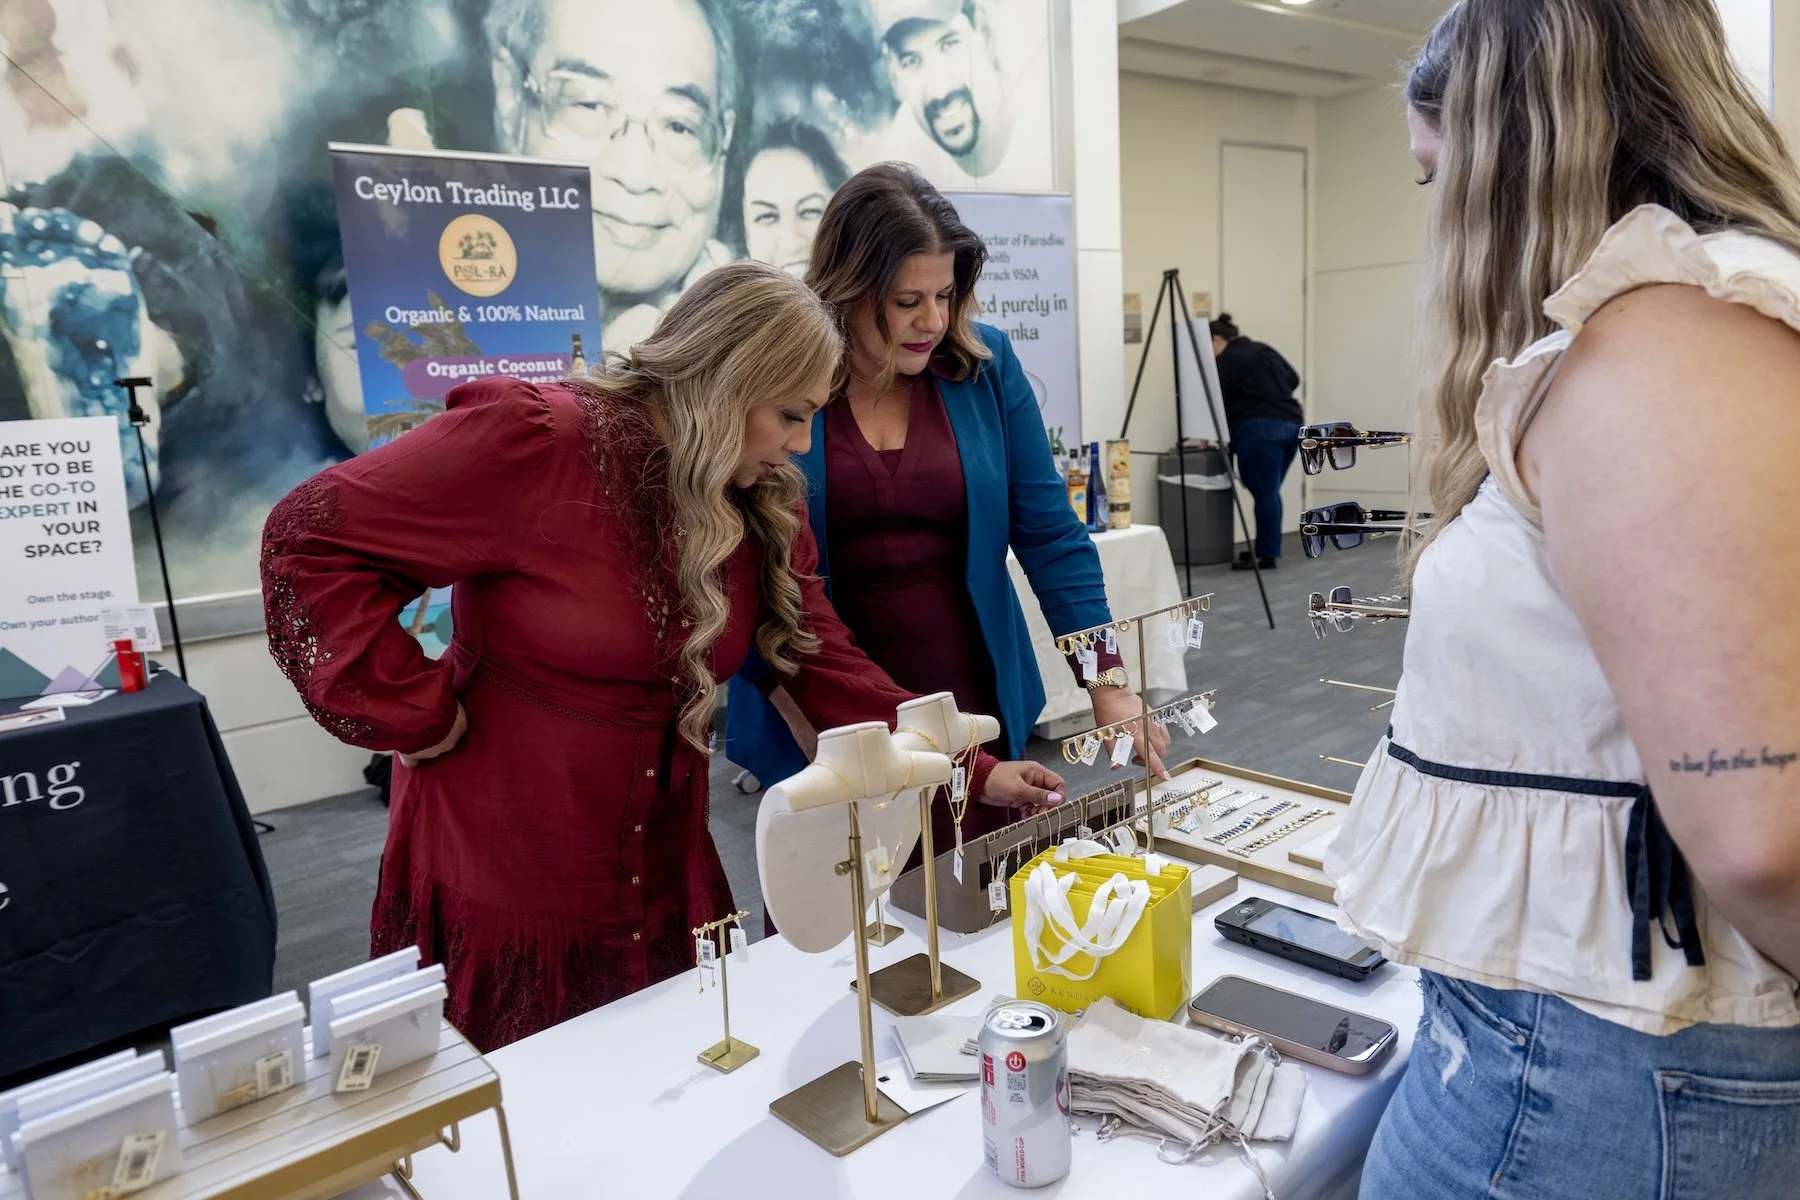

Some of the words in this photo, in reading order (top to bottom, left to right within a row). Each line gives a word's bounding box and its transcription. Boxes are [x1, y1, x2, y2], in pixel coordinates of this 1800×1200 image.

[354, 176, 443, 206] Ceylon
[446, 181, 536, 212] Trading
[539, 187, 580, 210] LLC
[1011, 233, 1022, 246] of
[1023, 233, 1065, 246] Paradise
[1001, 294, 1050, 319] purely
[1053, 293, 1068, 311] in
[385, 306, 454, 327] Organic
[457, 306, 472, 322] &
[476, 305, 523, 322] 100%
[525, 304, 585, 322] Natural
[426, 359, 495, 379] Organic
[497, 358, 564, 374] Coconut
[0, 443, 42, 458] ARE
[47, 440, 91, 455] YOU
[32, 462, 60, 476] TO
[67, 460, 94, 474] BE
[30, 480, 96, 497] GO-TO
[0, 502, 70, 520] EXPERT
[77, 500, 98, 514] IN
[42, 520, 101, 536] YOUR
[24, 540, 102, 558] SPACE?
[27, 594, 55, 604] Own
[56, 592, 77, 602] the
[79, 589, 115, 601] stage.
[0, 620, 27, 631] Own
[29, 617, 57, 630] your
[60, 613, 99, 625] author
